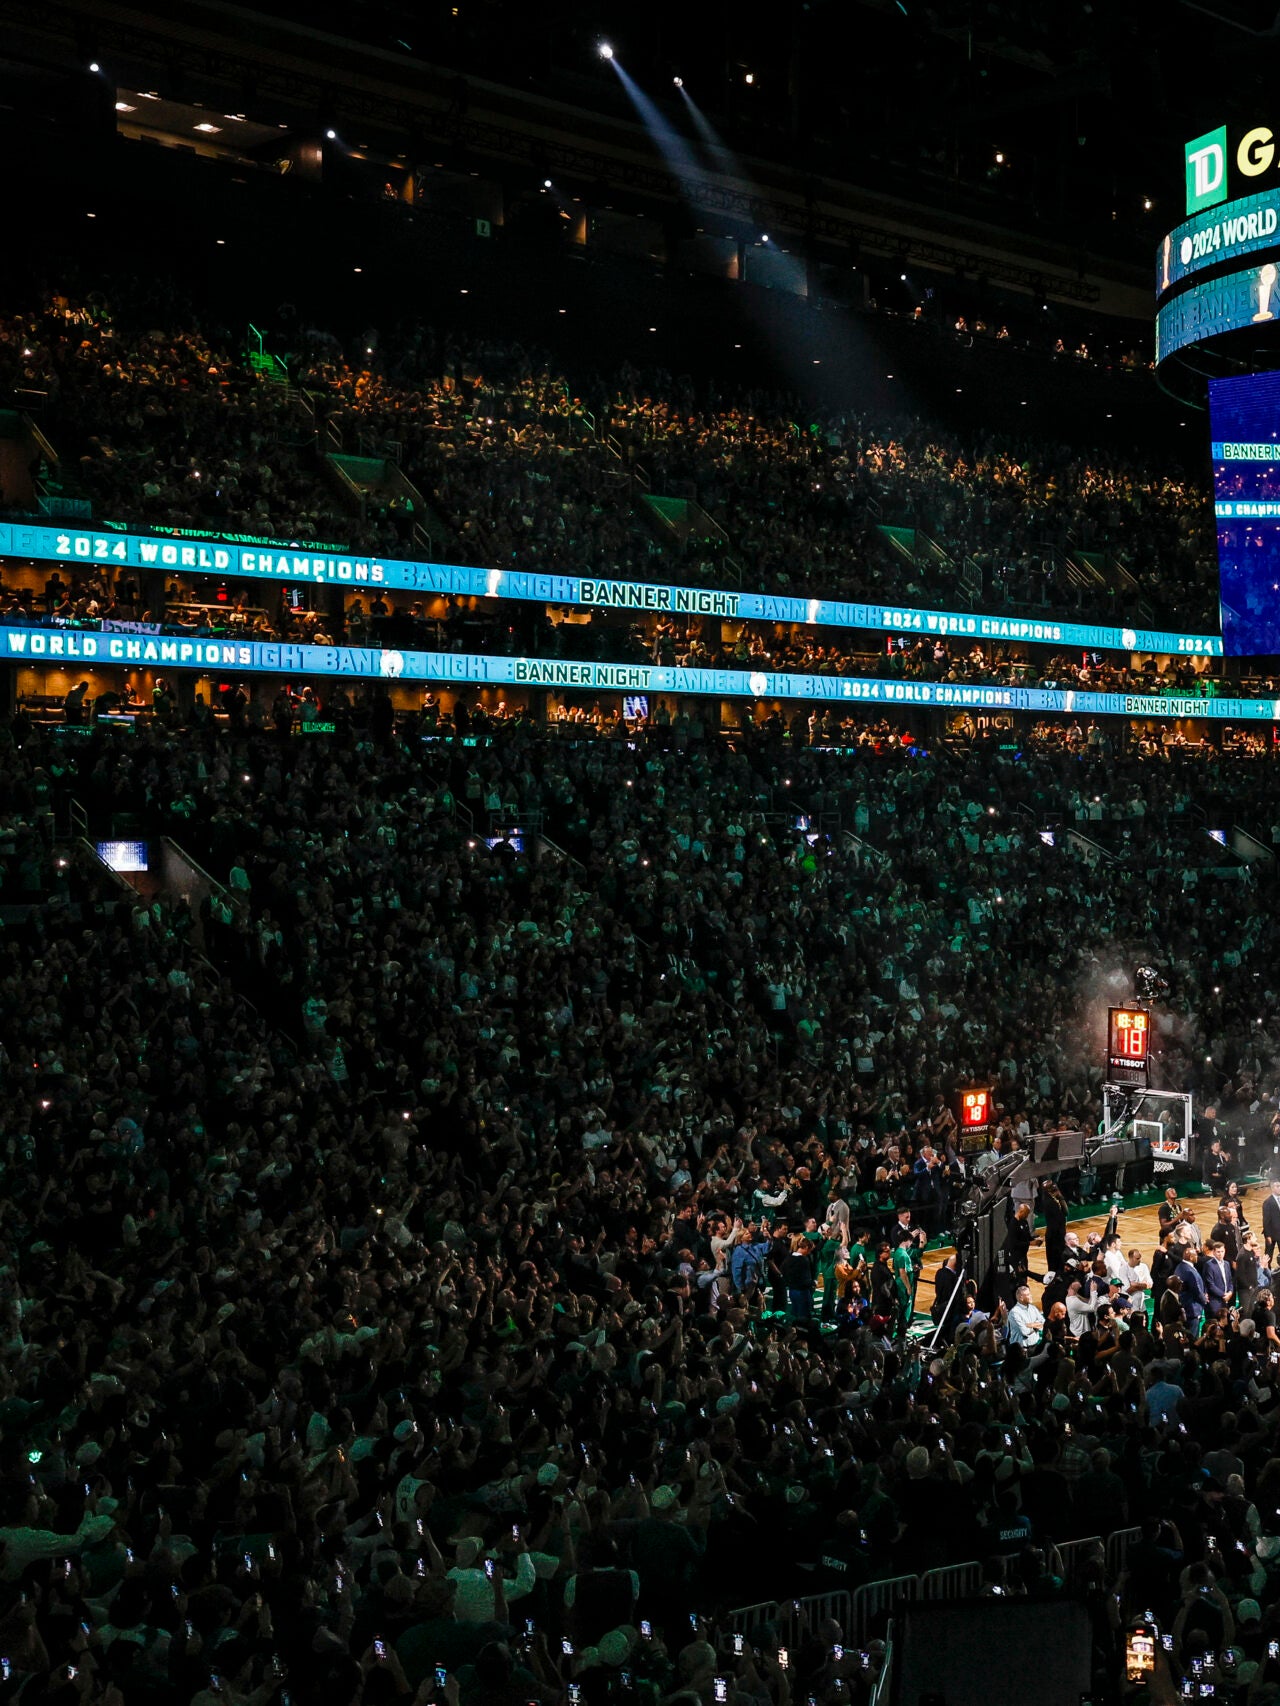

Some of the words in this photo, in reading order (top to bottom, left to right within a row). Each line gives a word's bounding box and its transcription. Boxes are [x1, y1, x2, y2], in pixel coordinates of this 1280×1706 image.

[1188, 144, 1225, 198] TD
[1193, 225, 1221, 260] 2024
[1222, 208, 1278, 247] WORLD
[1223, 443, 1272, 460] BANNER
[56, 534, 127, 561] 2024
[140, 543, 229, 569] WORLD
[241, 552, 384, 581] CHAMPIONS
[579, 580, 671, 611] BANNER
[675, 588, 740, 617] NIGHT
[883, 610, 922, 630] 2024
[927, 615, 977, 634] WORLD
[981, 619, 1061, 641] CHAMPIONS
[8, 632, 97, 657] WORLD
[110, 639, 251, 666] CHAMPIONS
[1178, 637, 1212, 653] 2024
[515, 661, 591, 685] BANNER
[596, 667, 651, 688] NIGHT
[844, 681, 881, 700] 2024
[884, 685, 930, 702] WORLD
[936, 688, 1011, 705] CHAMPIONS
[1125, 697, 1168, 715] BANNER
[1170, 698, 1210, 716] NIGHT
[1123, 1029, 1142, 1055] 18
[1120, 1059, 1145, 1069] TISSOT
[970, 1106, 981, 1121] 18
[1000, 1527, 1028, 1541] SECURITY
